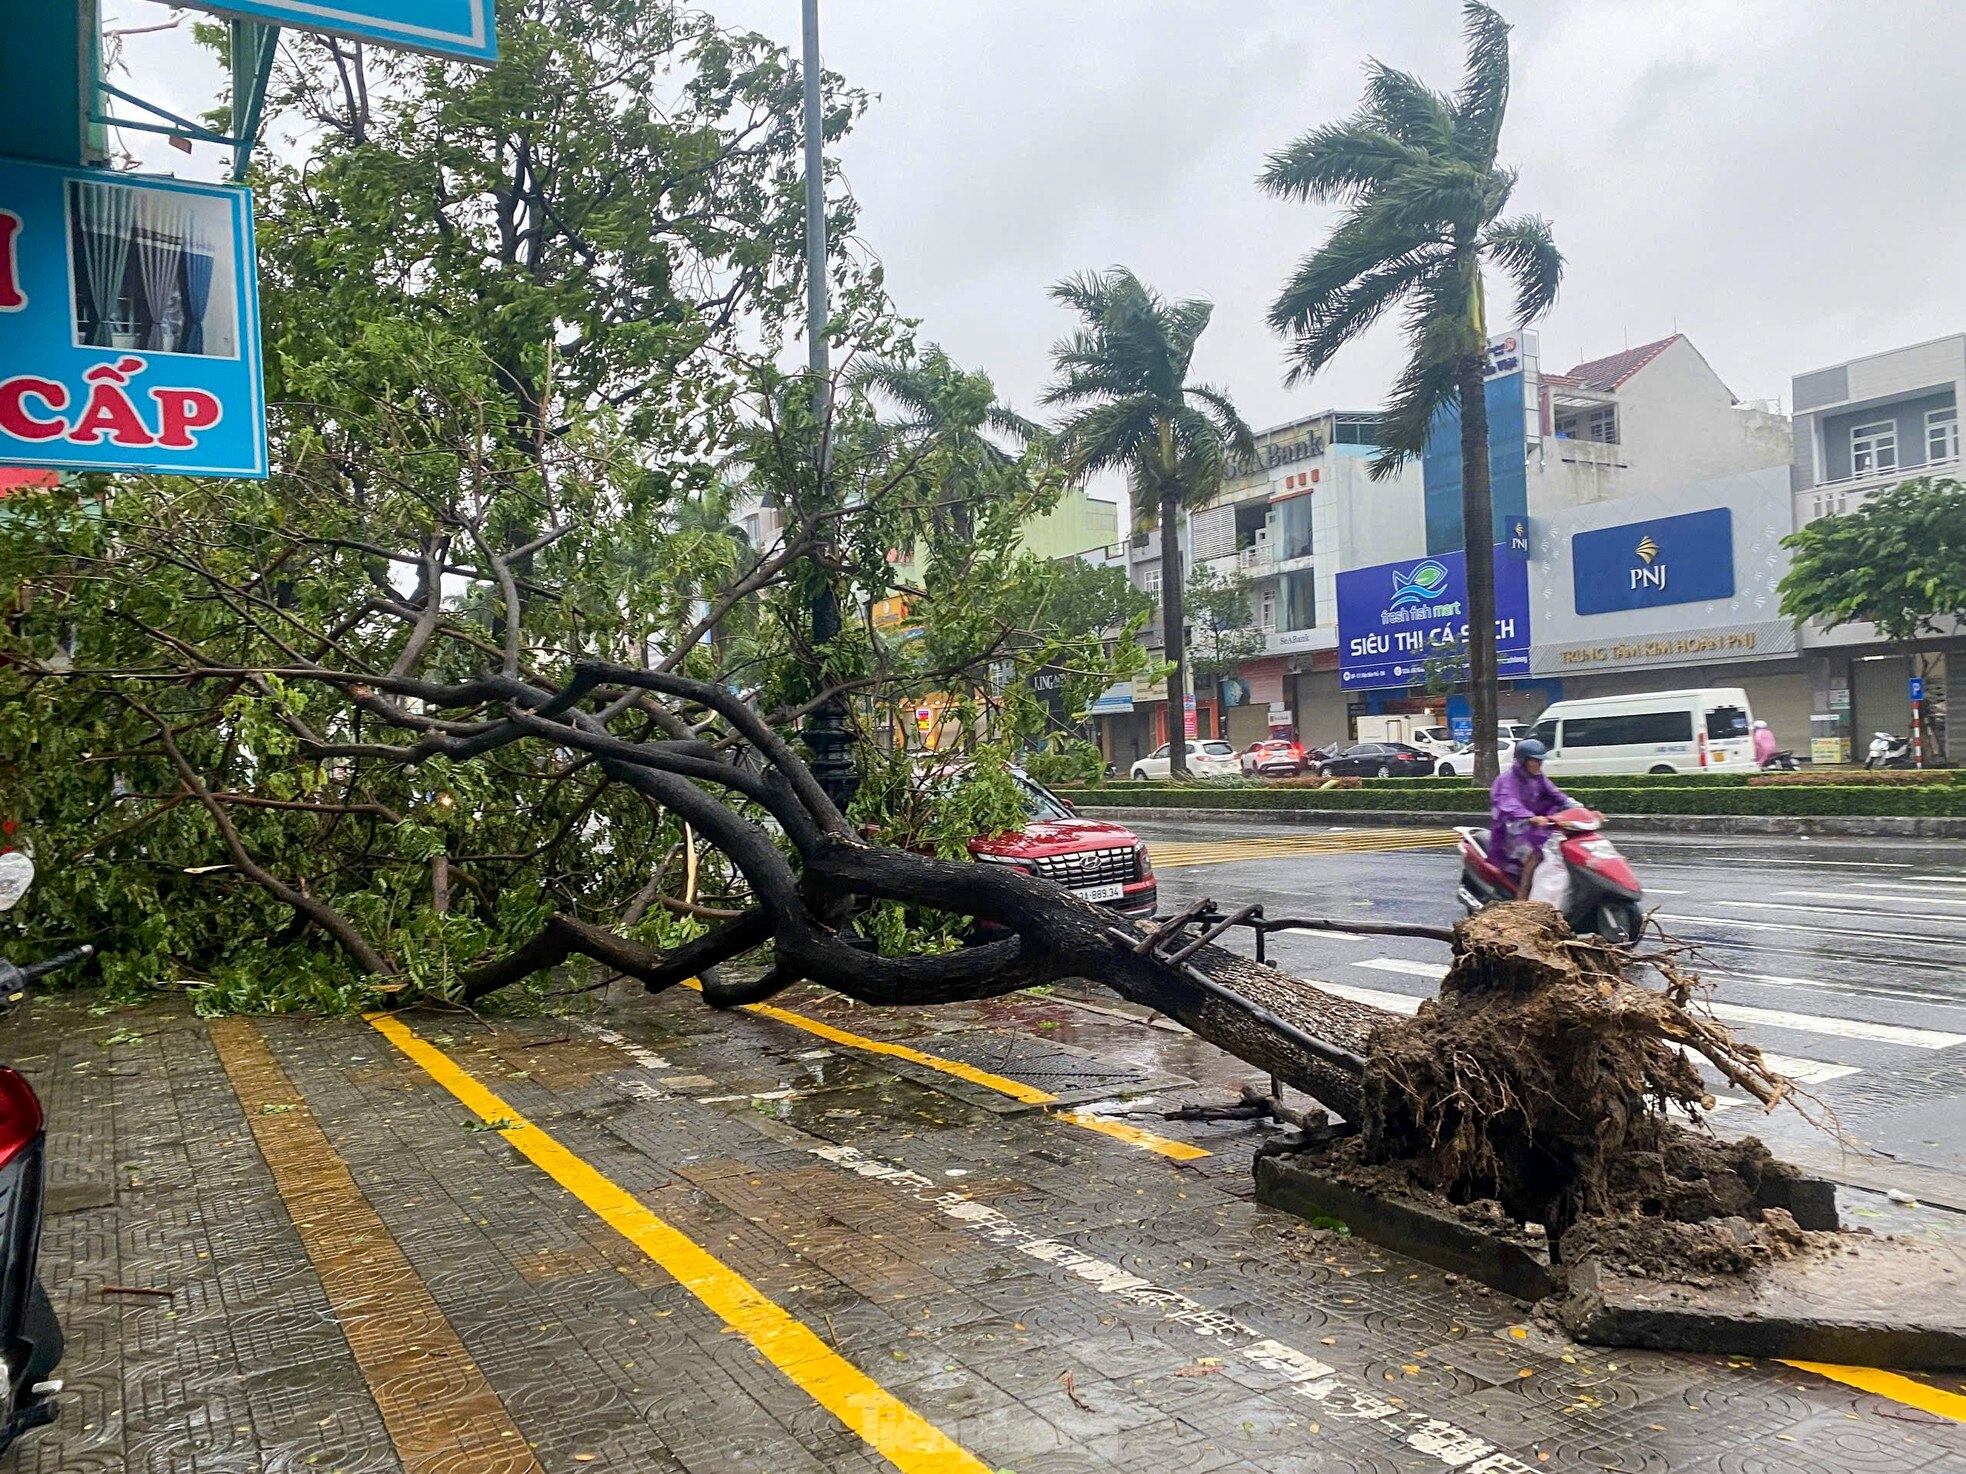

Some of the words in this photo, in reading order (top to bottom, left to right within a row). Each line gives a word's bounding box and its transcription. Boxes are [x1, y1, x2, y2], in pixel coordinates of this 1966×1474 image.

[0, 355, 221, 450] CẤP
[1512, 537, 1528, 551] PNJ
[1630, 564, 1667, 590] PNJ
[1381, 605, 1409, 625] fresh
[1410, 603, 1432, 621] fish
[1433, 600, 1462, 618] mart
[1350, 632, 1389, 657] SIÊU
[1394, 629, 1423, 652] THỊ
[1429, 621, 1455, 647] CÁ
[1561, 647, 1607, 664] TRUNG
[1644, 640, 1672, 657] KIM
[1727, 632, 1756, 650] PNJ
[1912, 682, 1921, 696] P
